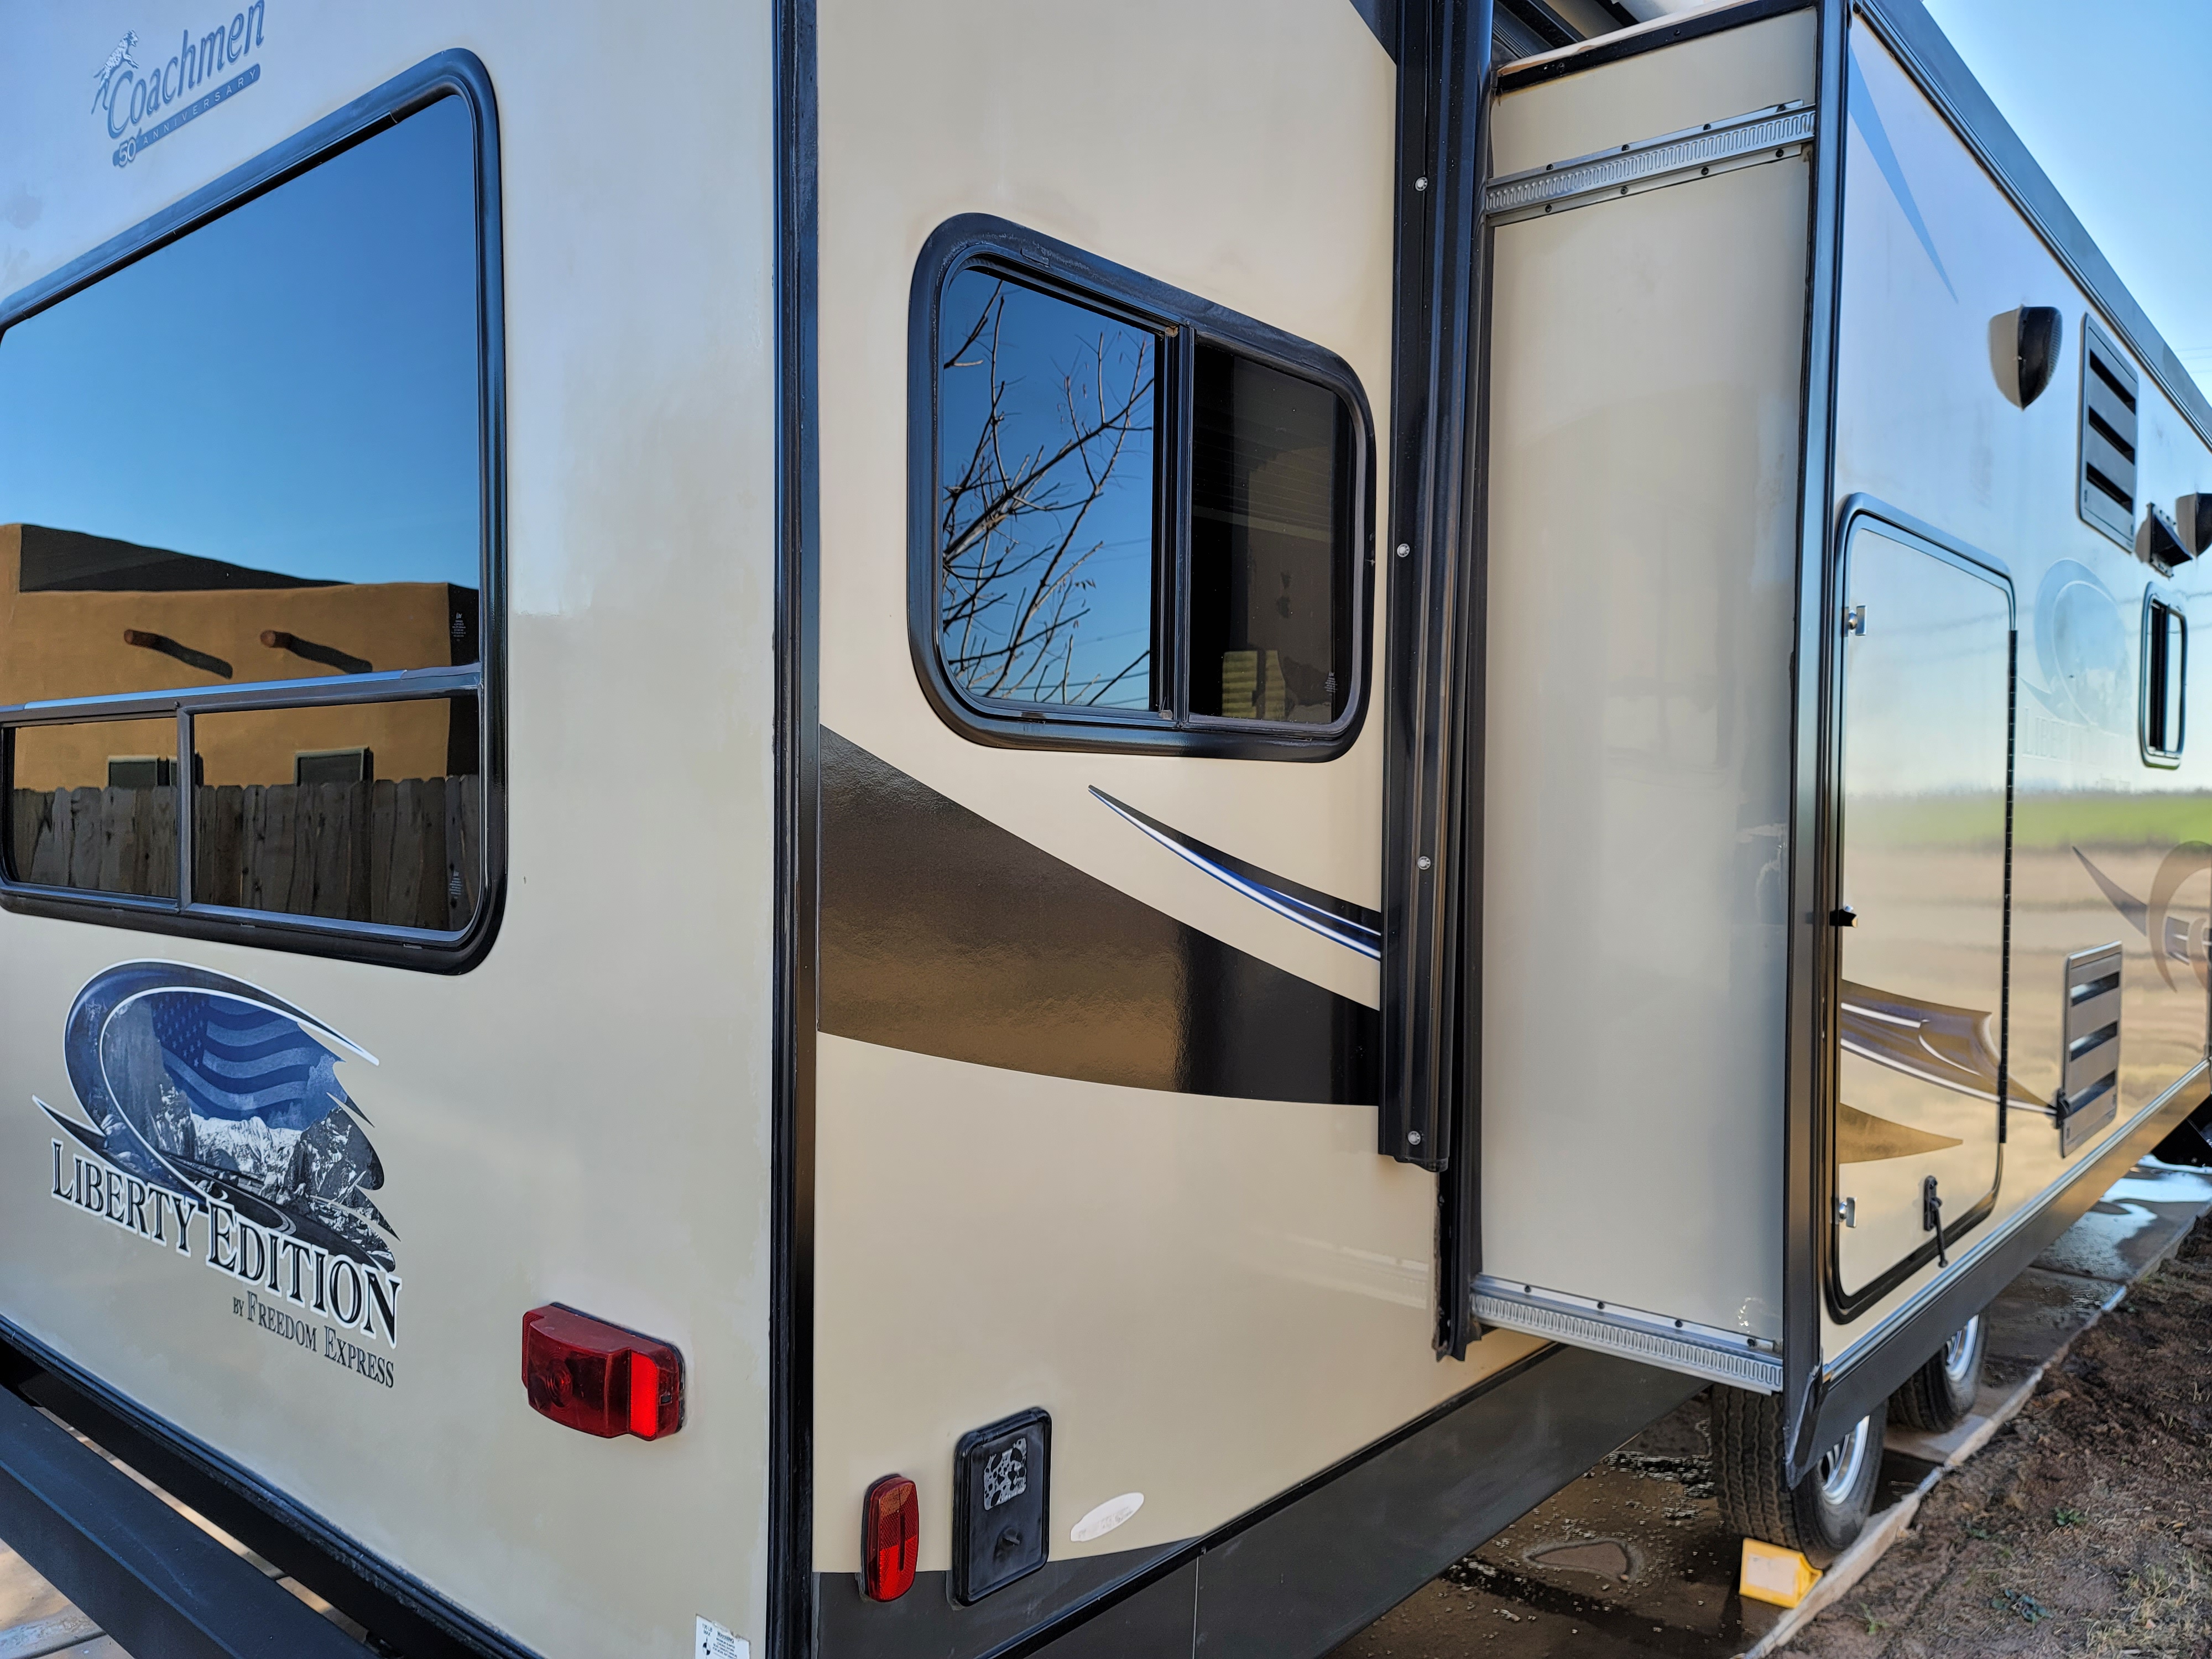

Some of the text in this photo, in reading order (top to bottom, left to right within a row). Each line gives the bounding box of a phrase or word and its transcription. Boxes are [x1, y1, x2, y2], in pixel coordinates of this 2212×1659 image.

[108, 0, 264, 138] Coachmen
[118, 69, 257, 166] 50 ANNIVERSARY
[53, 1141, 401, 1347] LIBERTY EDITION
[233, 1291, 394, 1388] BY FREEDOM EXPRESS
